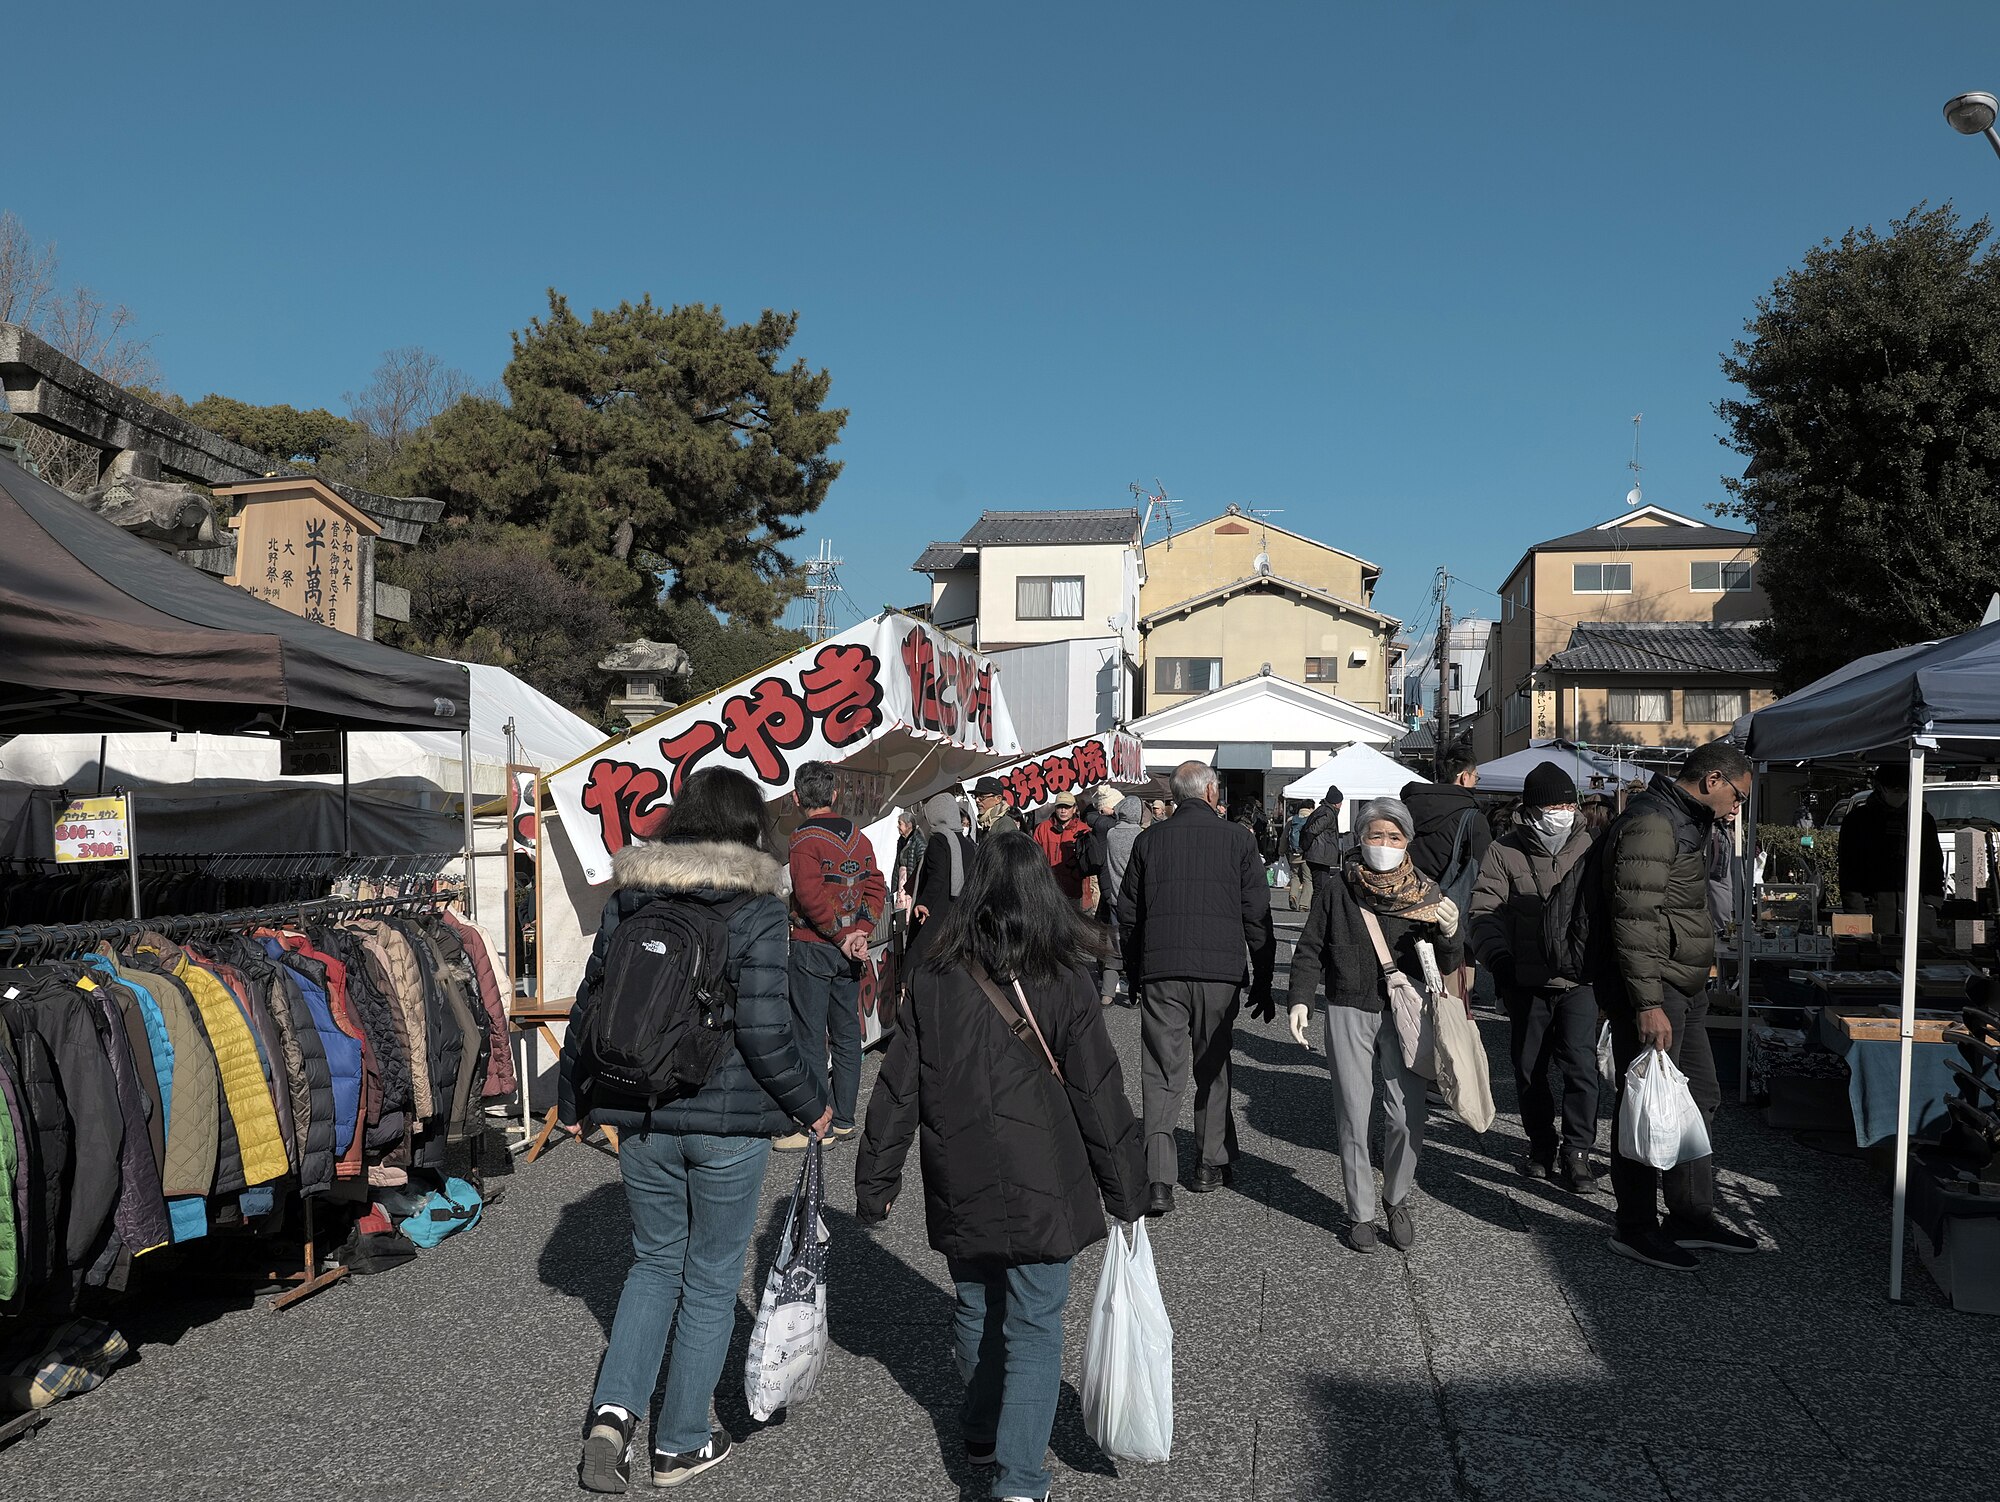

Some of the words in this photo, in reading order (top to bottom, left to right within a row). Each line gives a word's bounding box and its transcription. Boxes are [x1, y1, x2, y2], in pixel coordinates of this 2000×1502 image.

[266, 537, 279, 583] 北野祭
[281, 538, 295, 588] 大祭
[342, 521, 354, 593] 令和九年
[77, 842, 123, 858] 3900円
